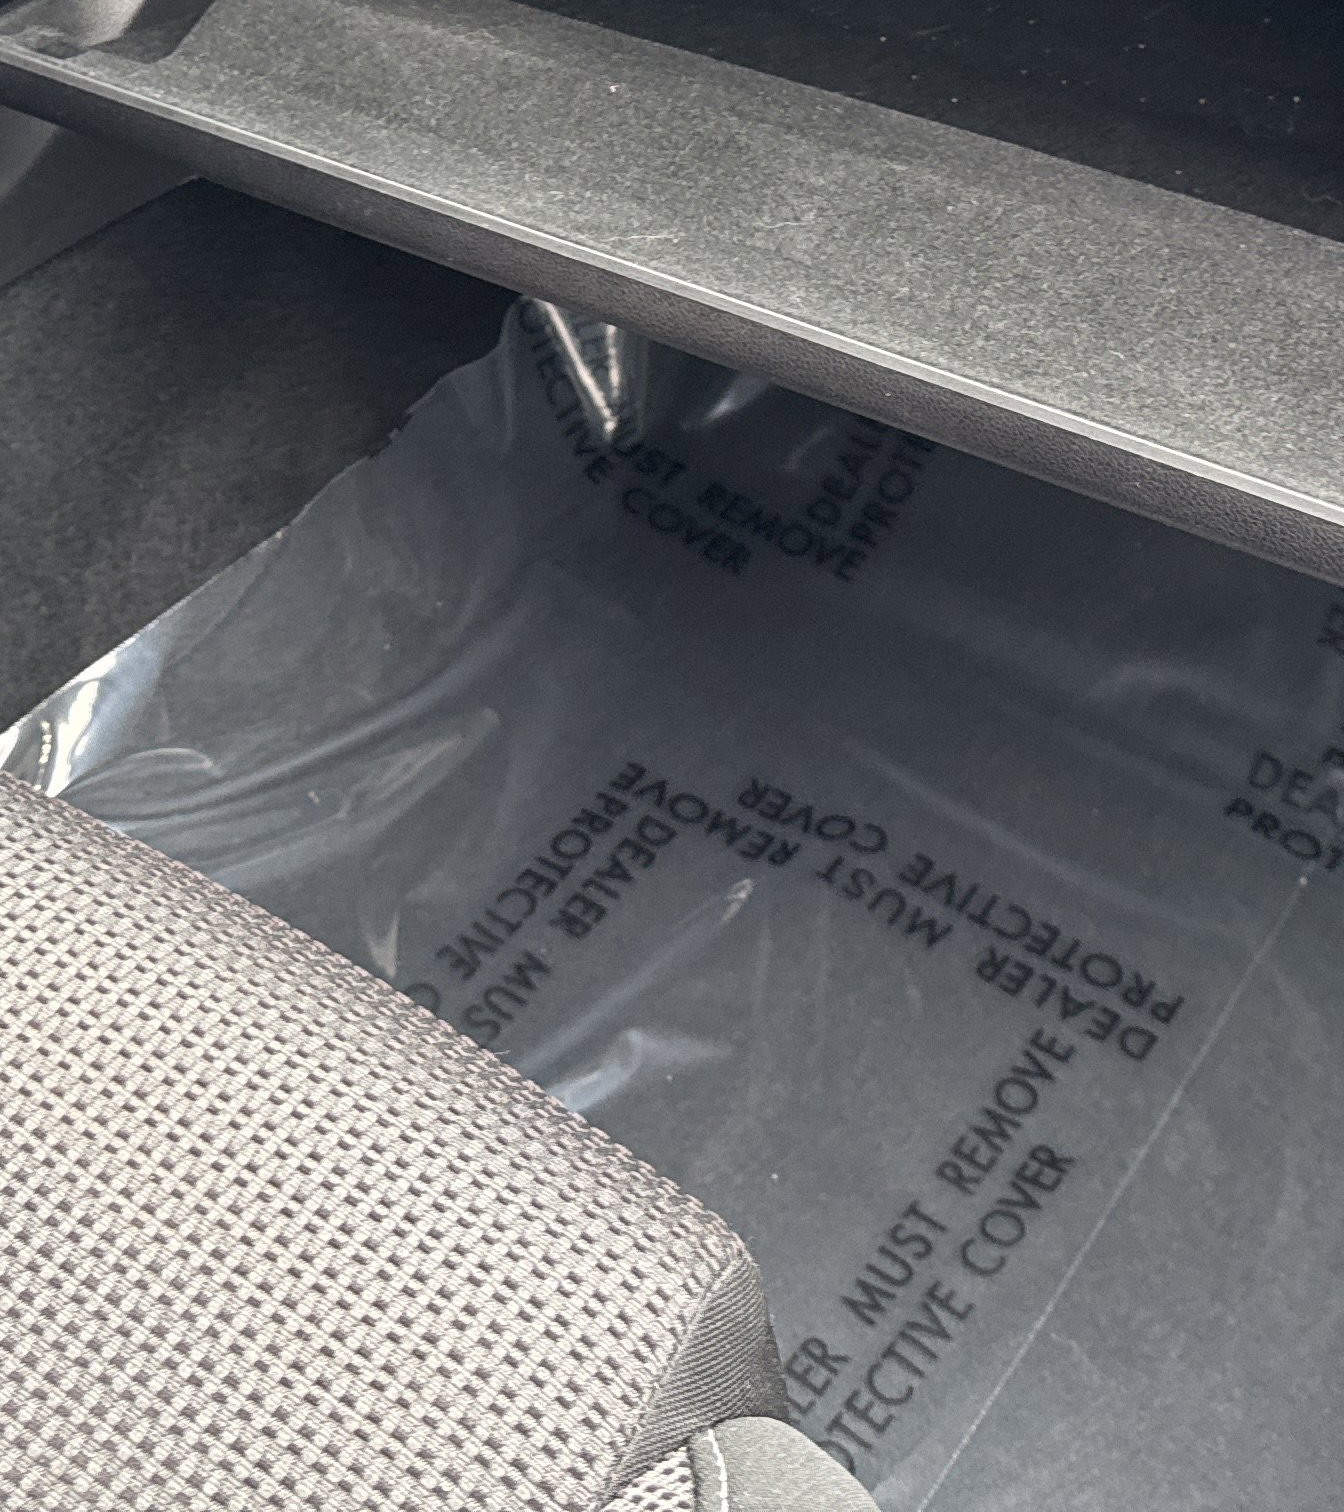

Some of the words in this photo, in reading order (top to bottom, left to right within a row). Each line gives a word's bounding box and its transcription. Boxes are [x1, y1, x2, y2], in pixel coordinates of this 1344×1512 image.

[620, 486, 752, 578] COVER
[609, 760, 801, 866] REMOVE
[737, 778, 889, 855] COVER
[435, 791, 633, 980] PROTECTIVE
[550, 813, 677, 940] DEALER
[816, 855, 954, 950] MUST
[898, 852, 1185, 1025] PROTECTIVE
[461, 949, 551, 1048] MUS
[975, 946, 1159, 1062] DEALER
[784, 1336, 853, 1416] LER
[840, 1200, 948, 1327] MUST
[934, 1027, 1075, 1196] REMOVE
[960, 1143, 1077, 1278] COVER
